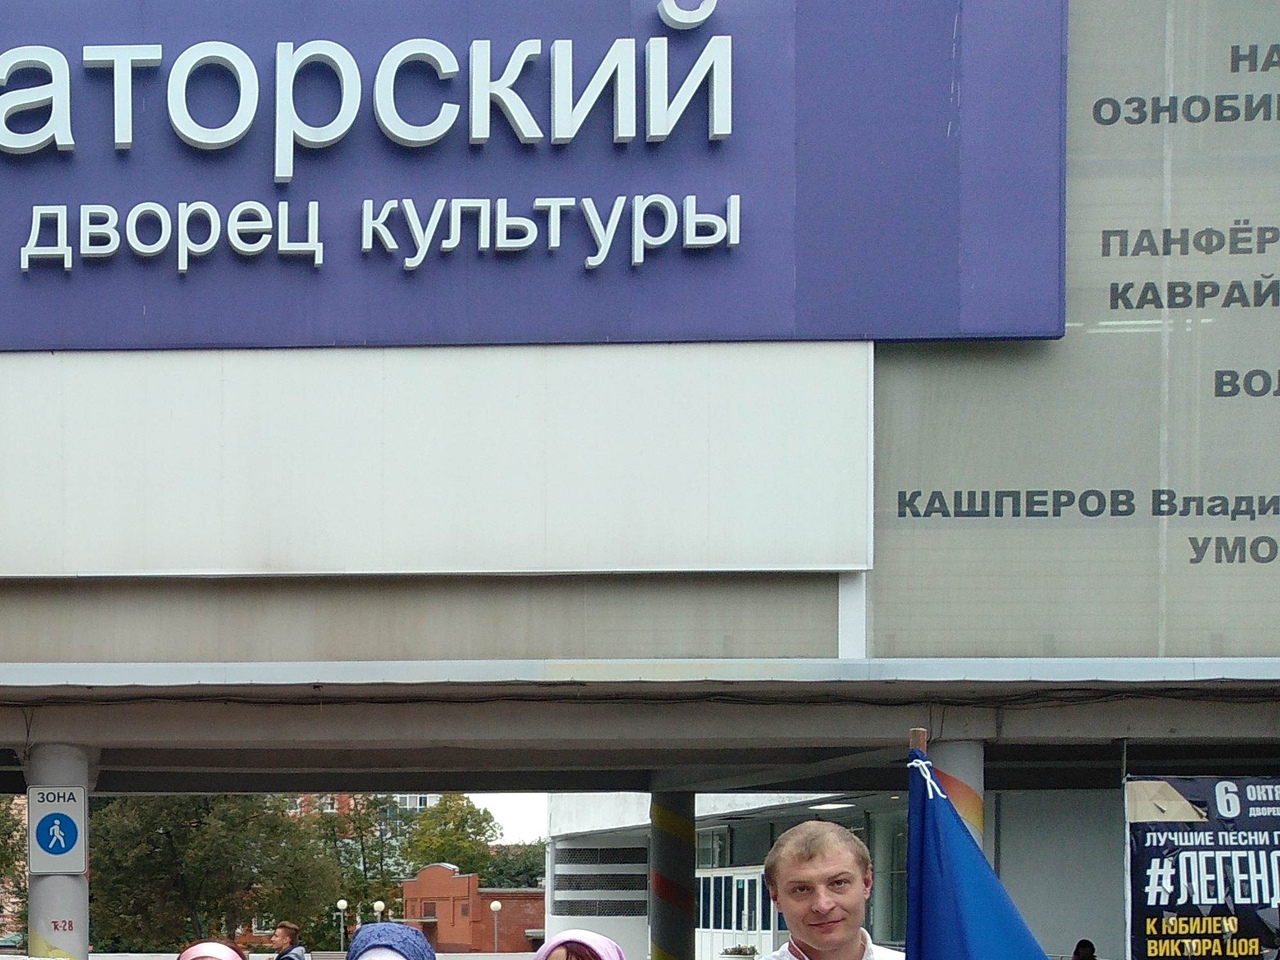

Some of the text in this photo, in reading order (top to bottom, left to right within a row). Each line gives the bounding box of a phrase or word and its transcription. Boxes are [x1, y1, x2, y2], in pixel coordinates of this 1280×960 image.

[1092, 94, 1280, 125] ОЗНОБИ
[21, 192, 742, 273] дворец культуры
[1109, 273, 1280, 310] КАВРАЙ
[1214, 369, 1280, 398] ВО
[896, 489, 1136, 518] КАШПЕРОВ
[37, 792, 76, 803] ЗОНА
[1215, 781, 1240, 817] 6
[1144, 831, 1215, 847] ЛУЧШИЕ
[1218, 831, 1271, 846] ПЕСНИ
[1146, 916, 1238, 935] К ЮБИЛЕЮ
[1147, 938, 1260, 957] ВИКТОРА ЦОЯ
